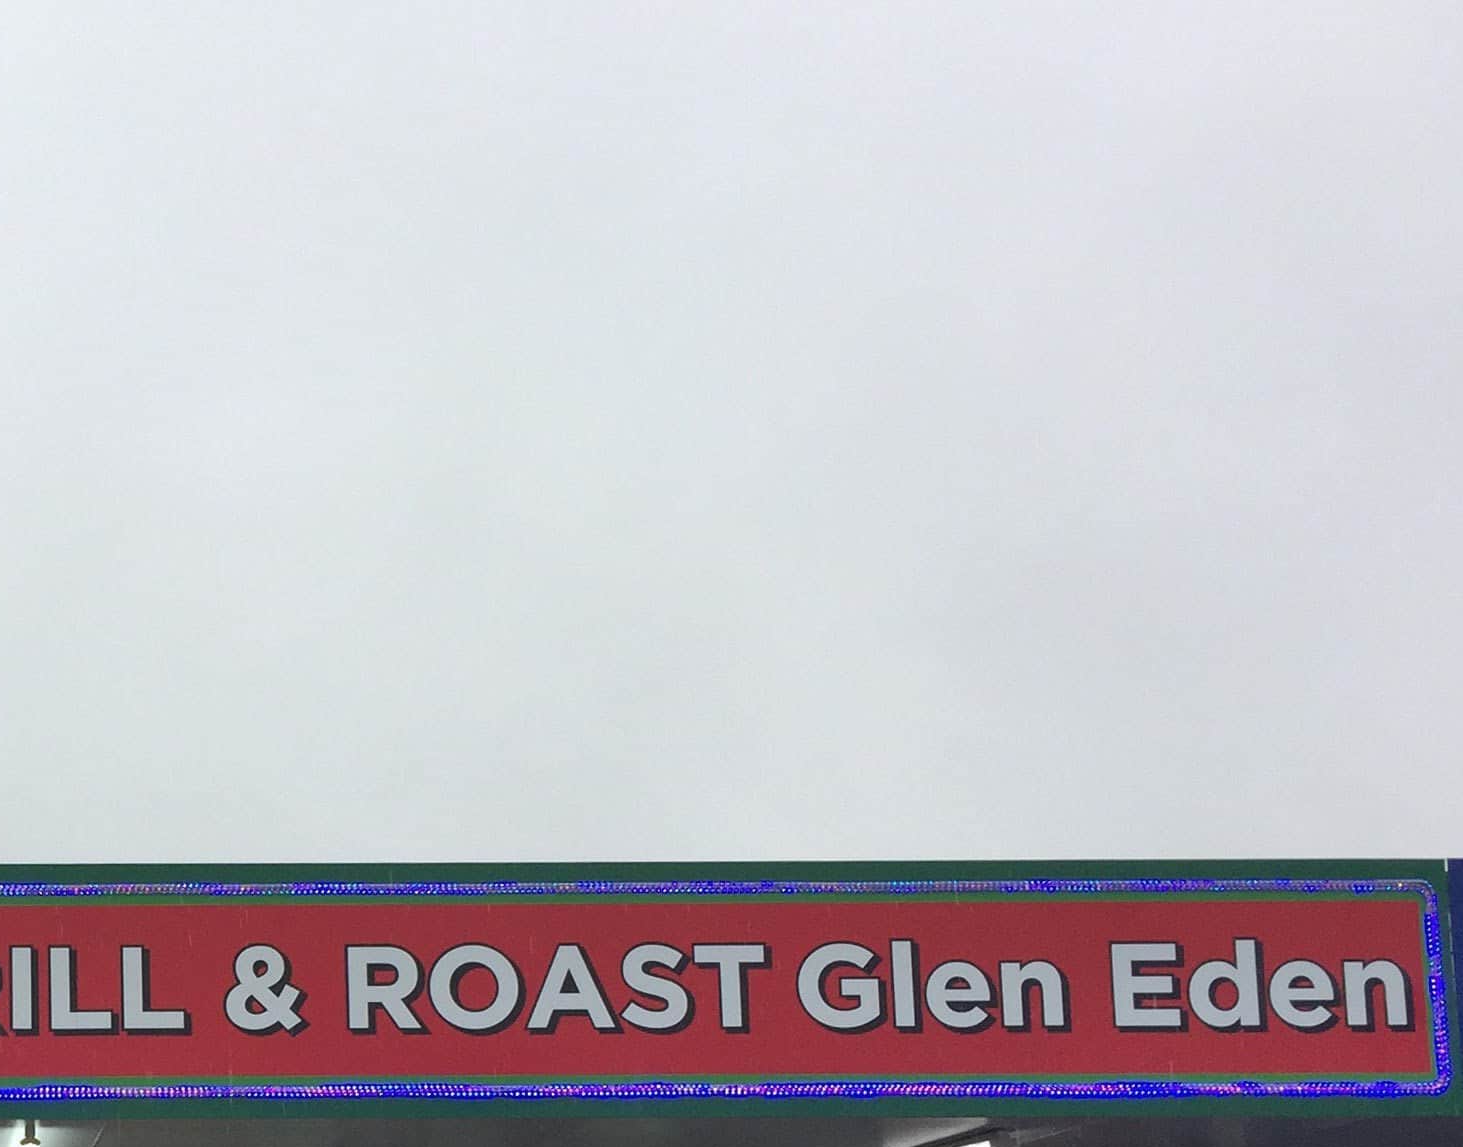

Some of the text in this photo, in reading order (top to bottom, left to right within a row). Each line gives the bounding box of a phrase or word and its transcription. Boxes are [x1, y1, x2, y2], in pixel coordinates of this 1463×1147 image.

[225, 944, 306, 1035] &
[347, 943, 776, 1034] ROAST
[797, 938, 1072, 1032] Glen
[1110, 938, 1414, 1031] Eden
